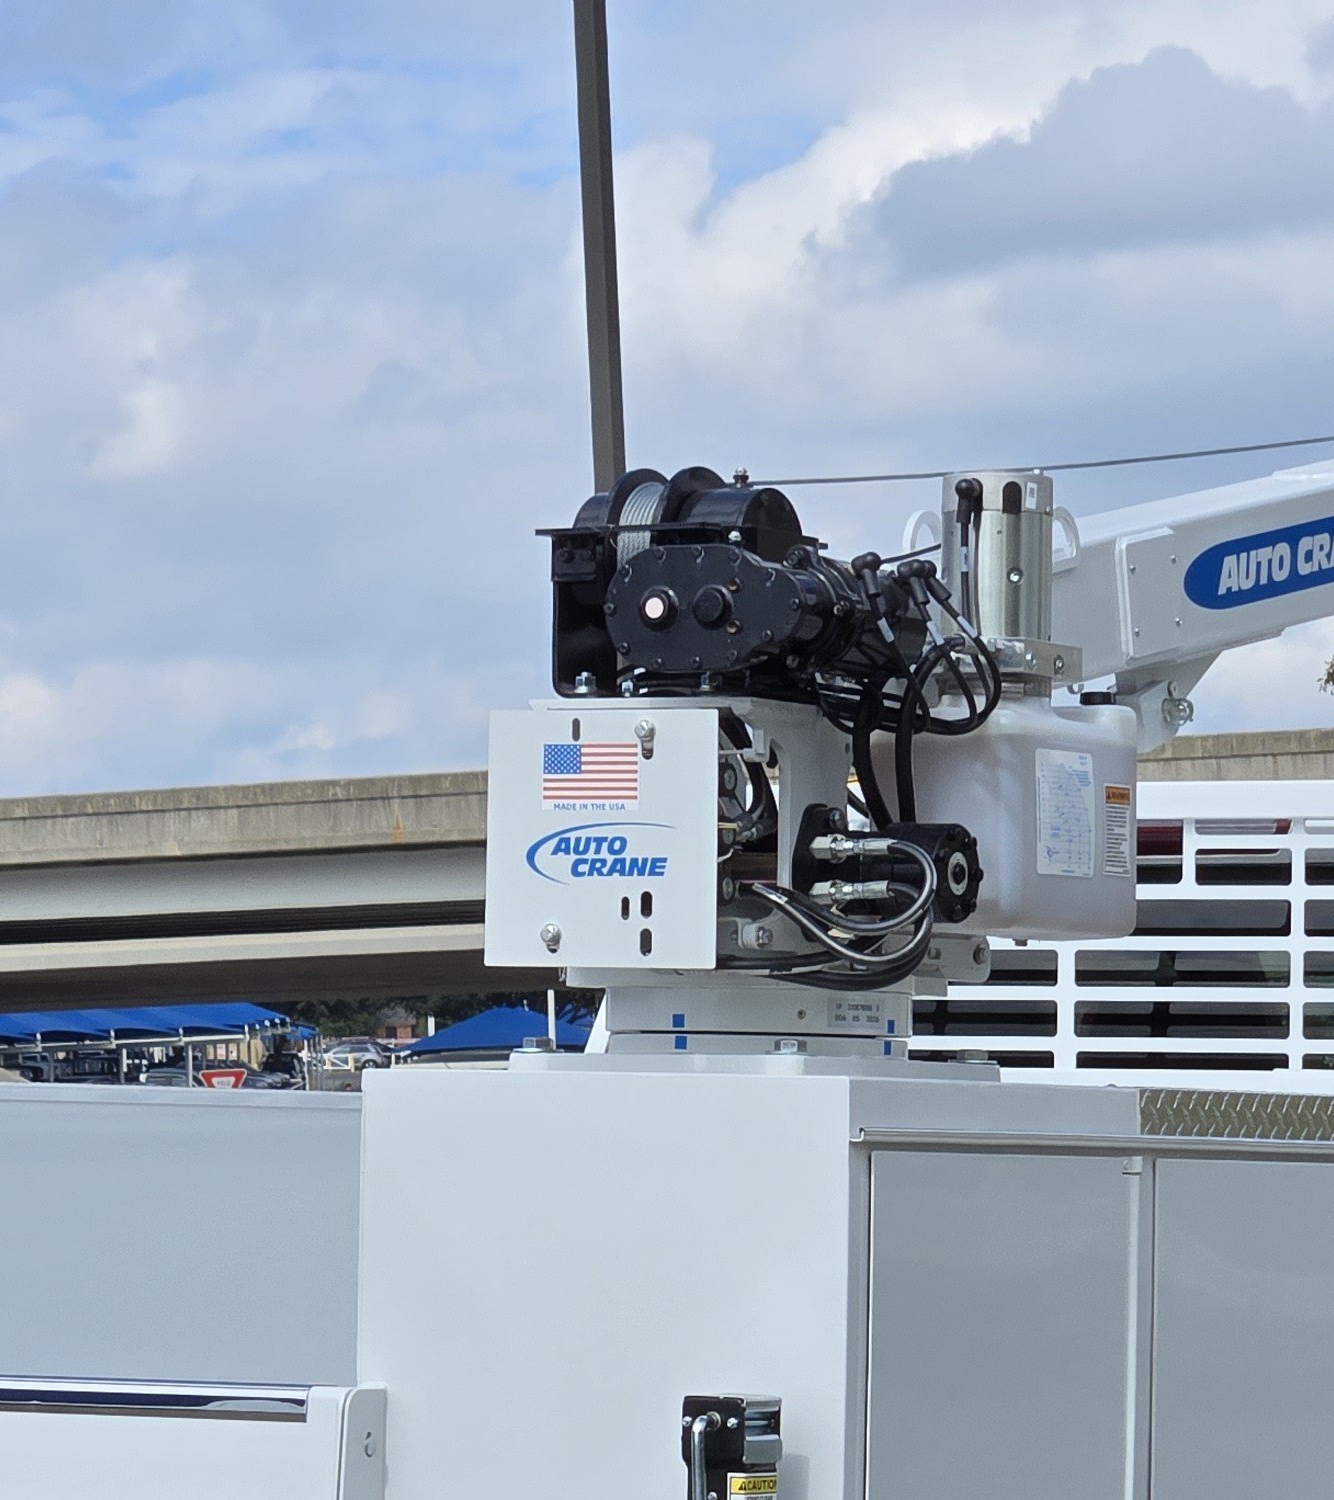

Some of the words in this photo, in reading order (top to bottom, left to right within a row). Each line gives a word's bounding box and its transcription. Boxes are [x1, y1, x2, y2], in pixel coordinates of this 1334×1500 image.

[1217, 541, 1290, 596] AUTO
[553, 803, 577, 811] MADE
[579, 803, 588, 811] IN
[591, 803, 606, 811] THE
[608, 803, 626, 811] USA
[550, 836, 628, 856] AUTO
[570, 857, 668, 878] CRANE
